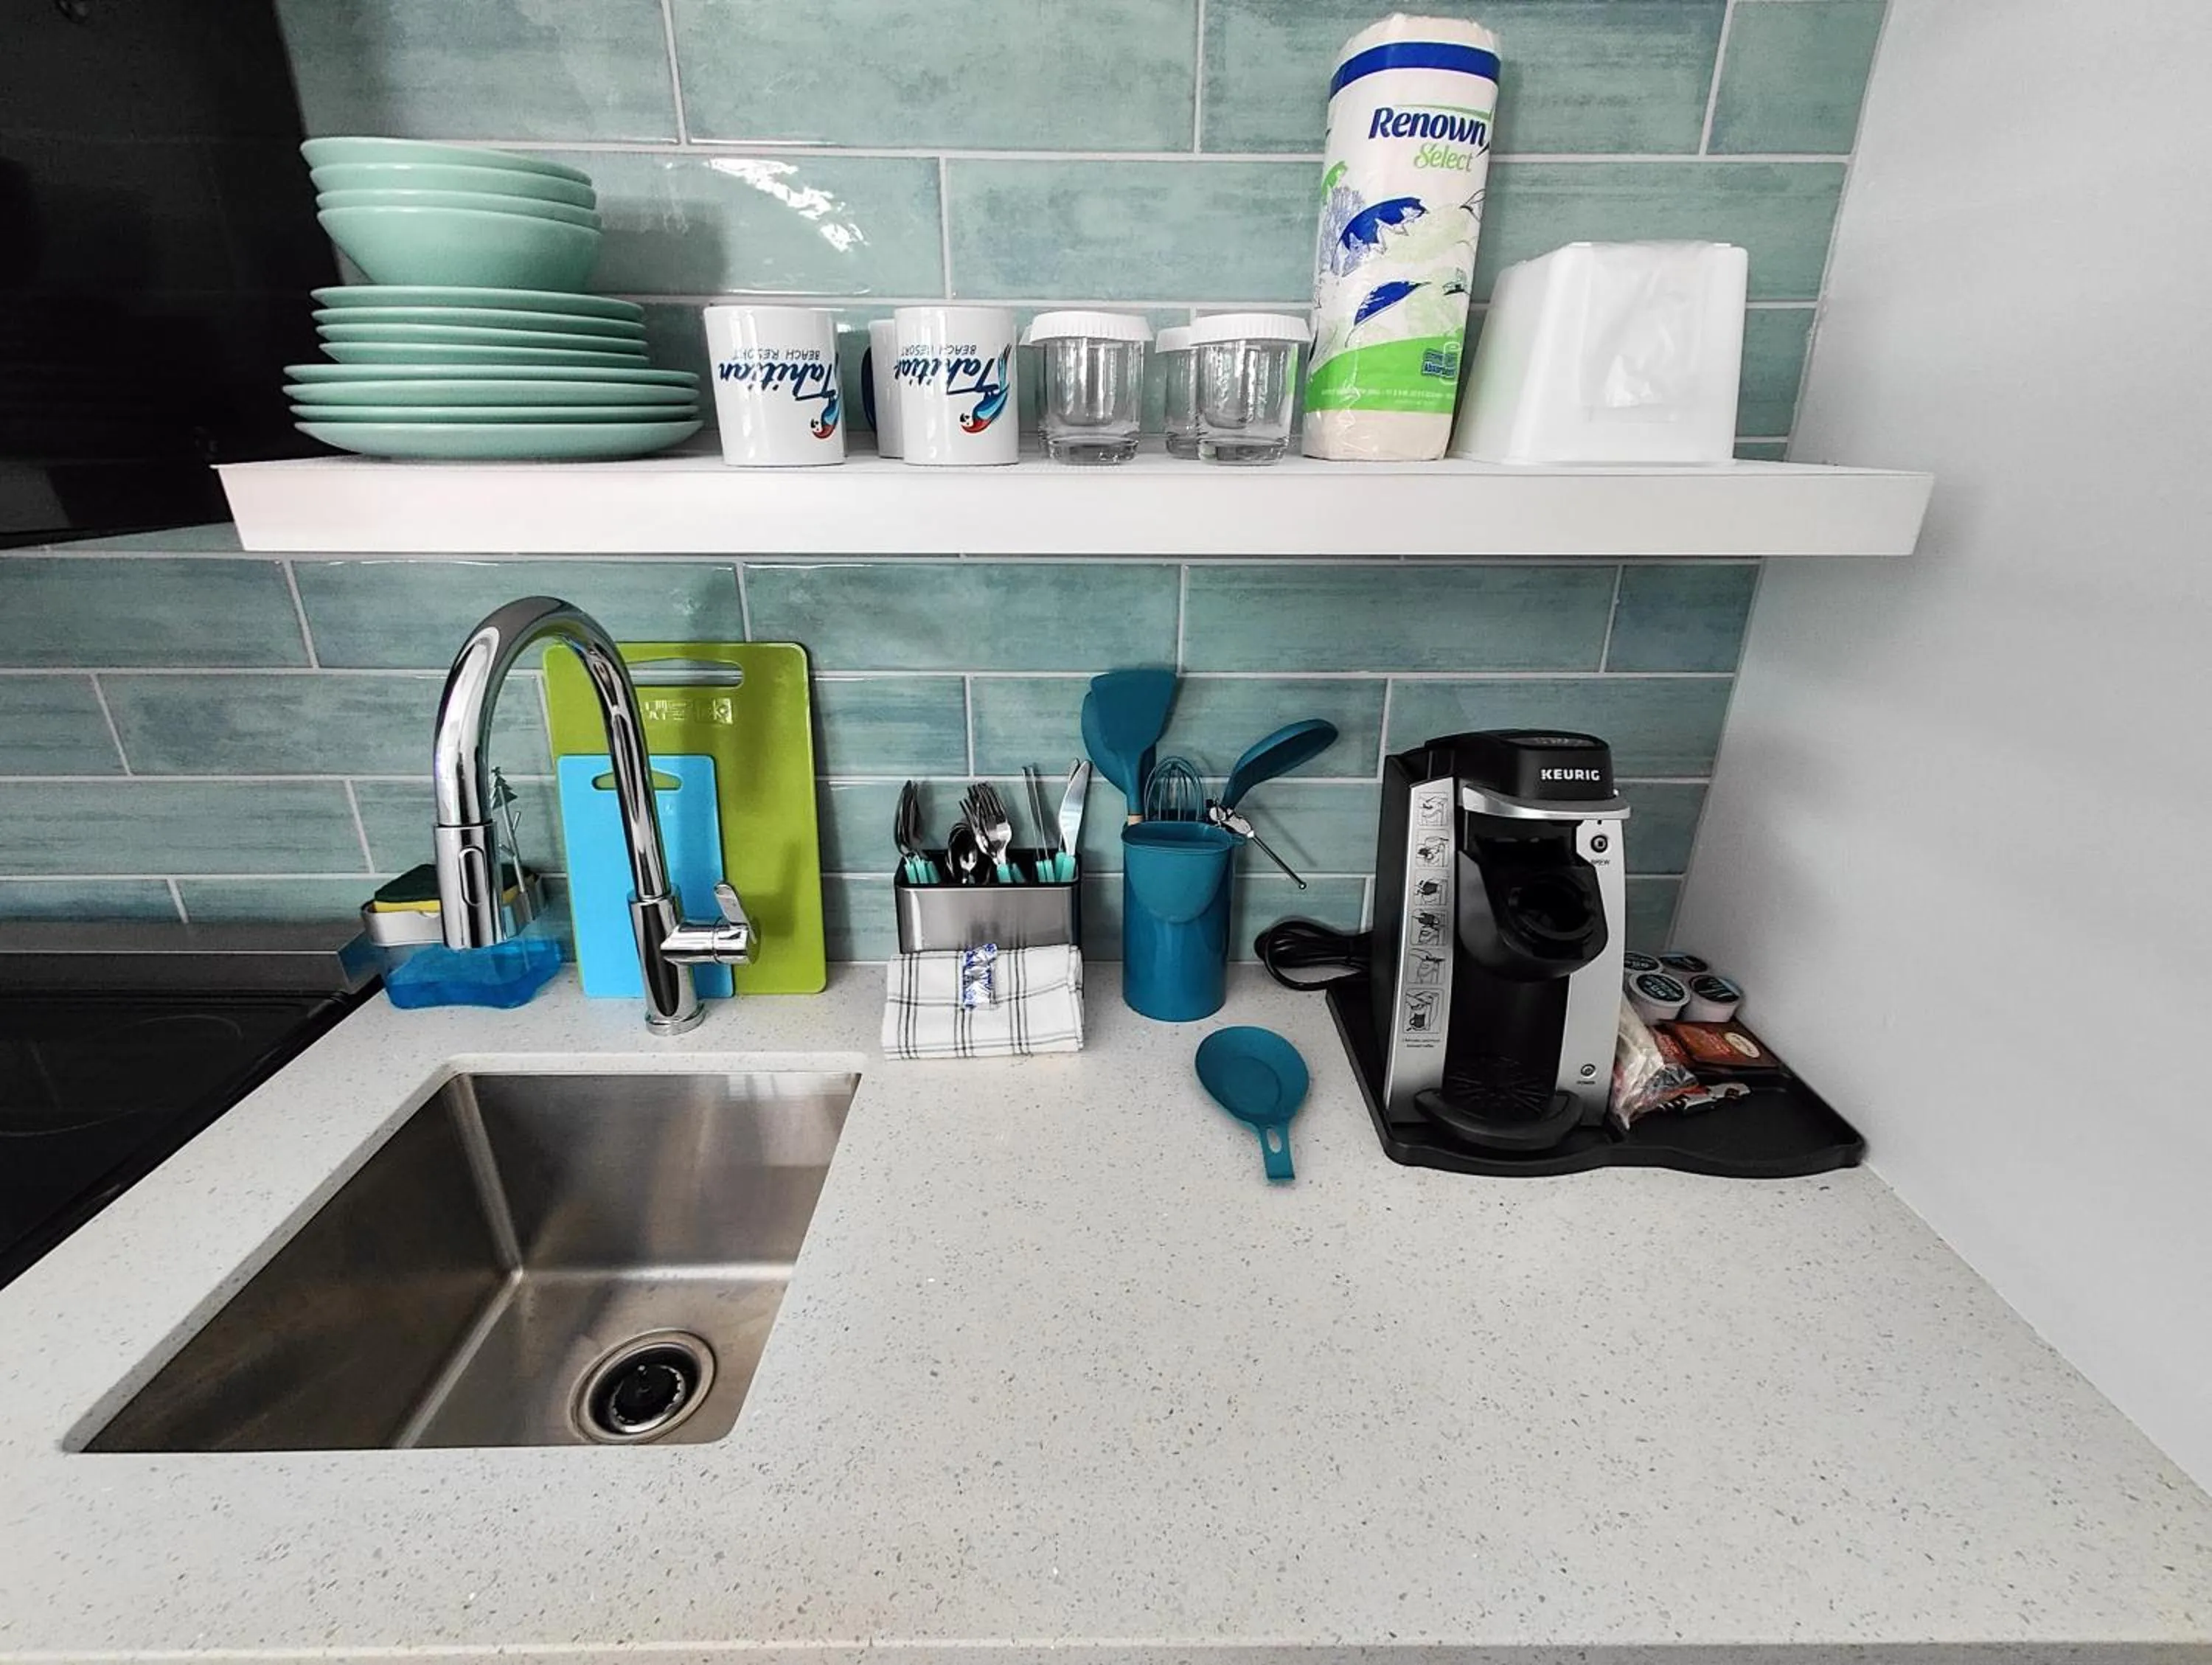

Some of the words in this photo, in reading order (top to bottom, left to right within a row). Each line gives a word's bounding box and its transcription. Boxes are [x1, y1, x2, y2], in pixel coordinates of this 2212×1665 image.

[1368, 107, 1486, 147] Renown
[1413, 142, 1474, 173] Select
[785, 350, 821, 361] BEACH
[718, 362, 836, 401] Tahitian
[1540, 768, 1601, 781] KEURIG
